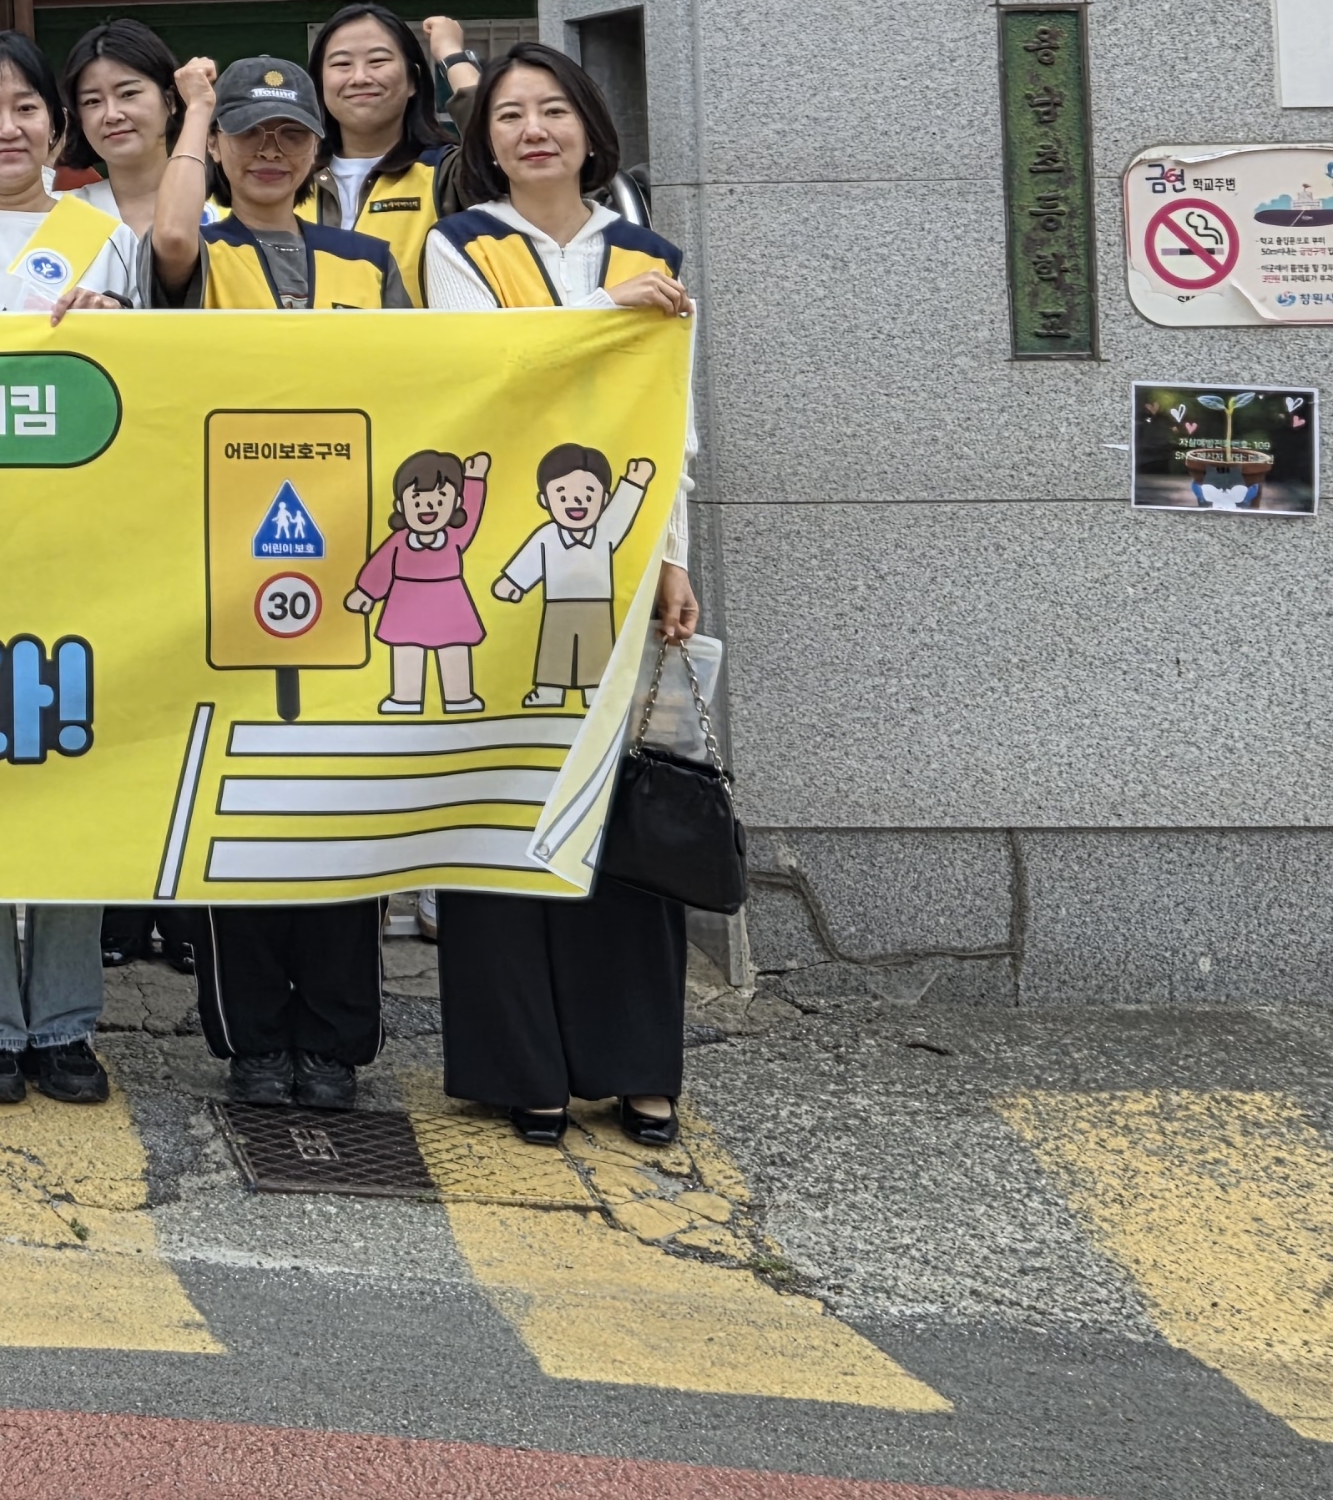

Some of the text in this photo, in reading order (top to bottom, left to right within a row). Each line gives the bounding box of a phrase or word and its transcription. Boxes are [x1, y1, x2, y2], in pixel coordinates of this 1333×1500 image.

[1023, 25, 1072, 339] 용남초등학교
[1193, 177, 1236, 191] 학교주변
[224, 442, 351, 460] 어린이보호구역
[262, 543, 315, 554] 어린이 보호
[267, 591, 310, 620] 30
